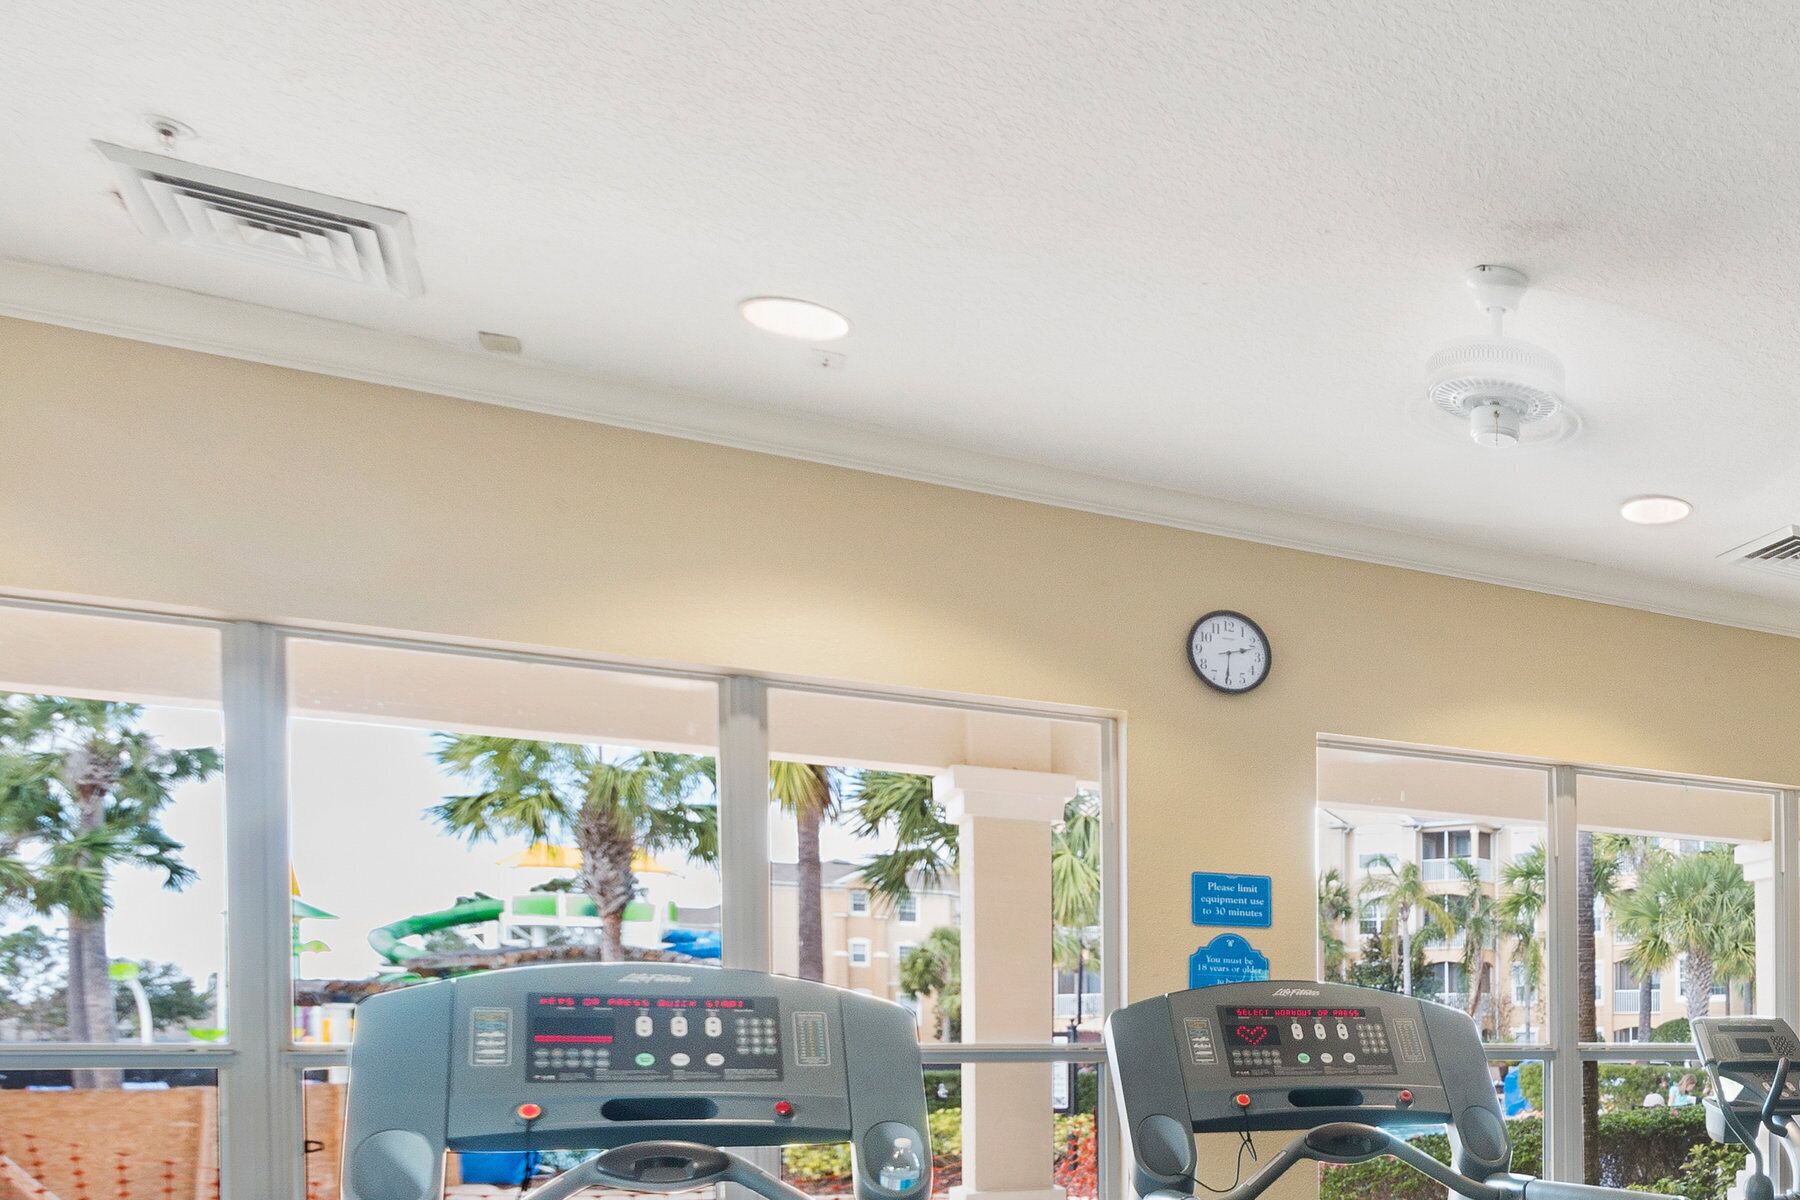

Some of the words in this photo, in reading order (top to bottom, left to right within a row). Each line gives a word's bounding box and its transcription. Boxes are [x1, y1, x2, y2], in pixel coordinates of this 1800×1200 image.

[1212, 623, 1220, 634] 11
[1224, 620, 1234, 632] 12
[1201, 632, 1212, 642] 10
[1249, 638, 1256, 648] 2
[1196, 644, 1202, 653] 9
[1254, 653, 1260, 663] 3
[1200, 659, 1207, 669] 8
[1239, 673, 1245, 684] 5
[1207, 882, 1235, 891] Please
[1238, 884, 1257, 893] limit
[1201, 895, 1247, 905] equipment
[1216, 907, 1226, 915] 30
[1228, 908, 1262, 917] minutes
[1245, 957, 1253, 965] be
[1272, 988, 1291, 997] Life
[1236, 1008, 1269, 1016] SELECT
